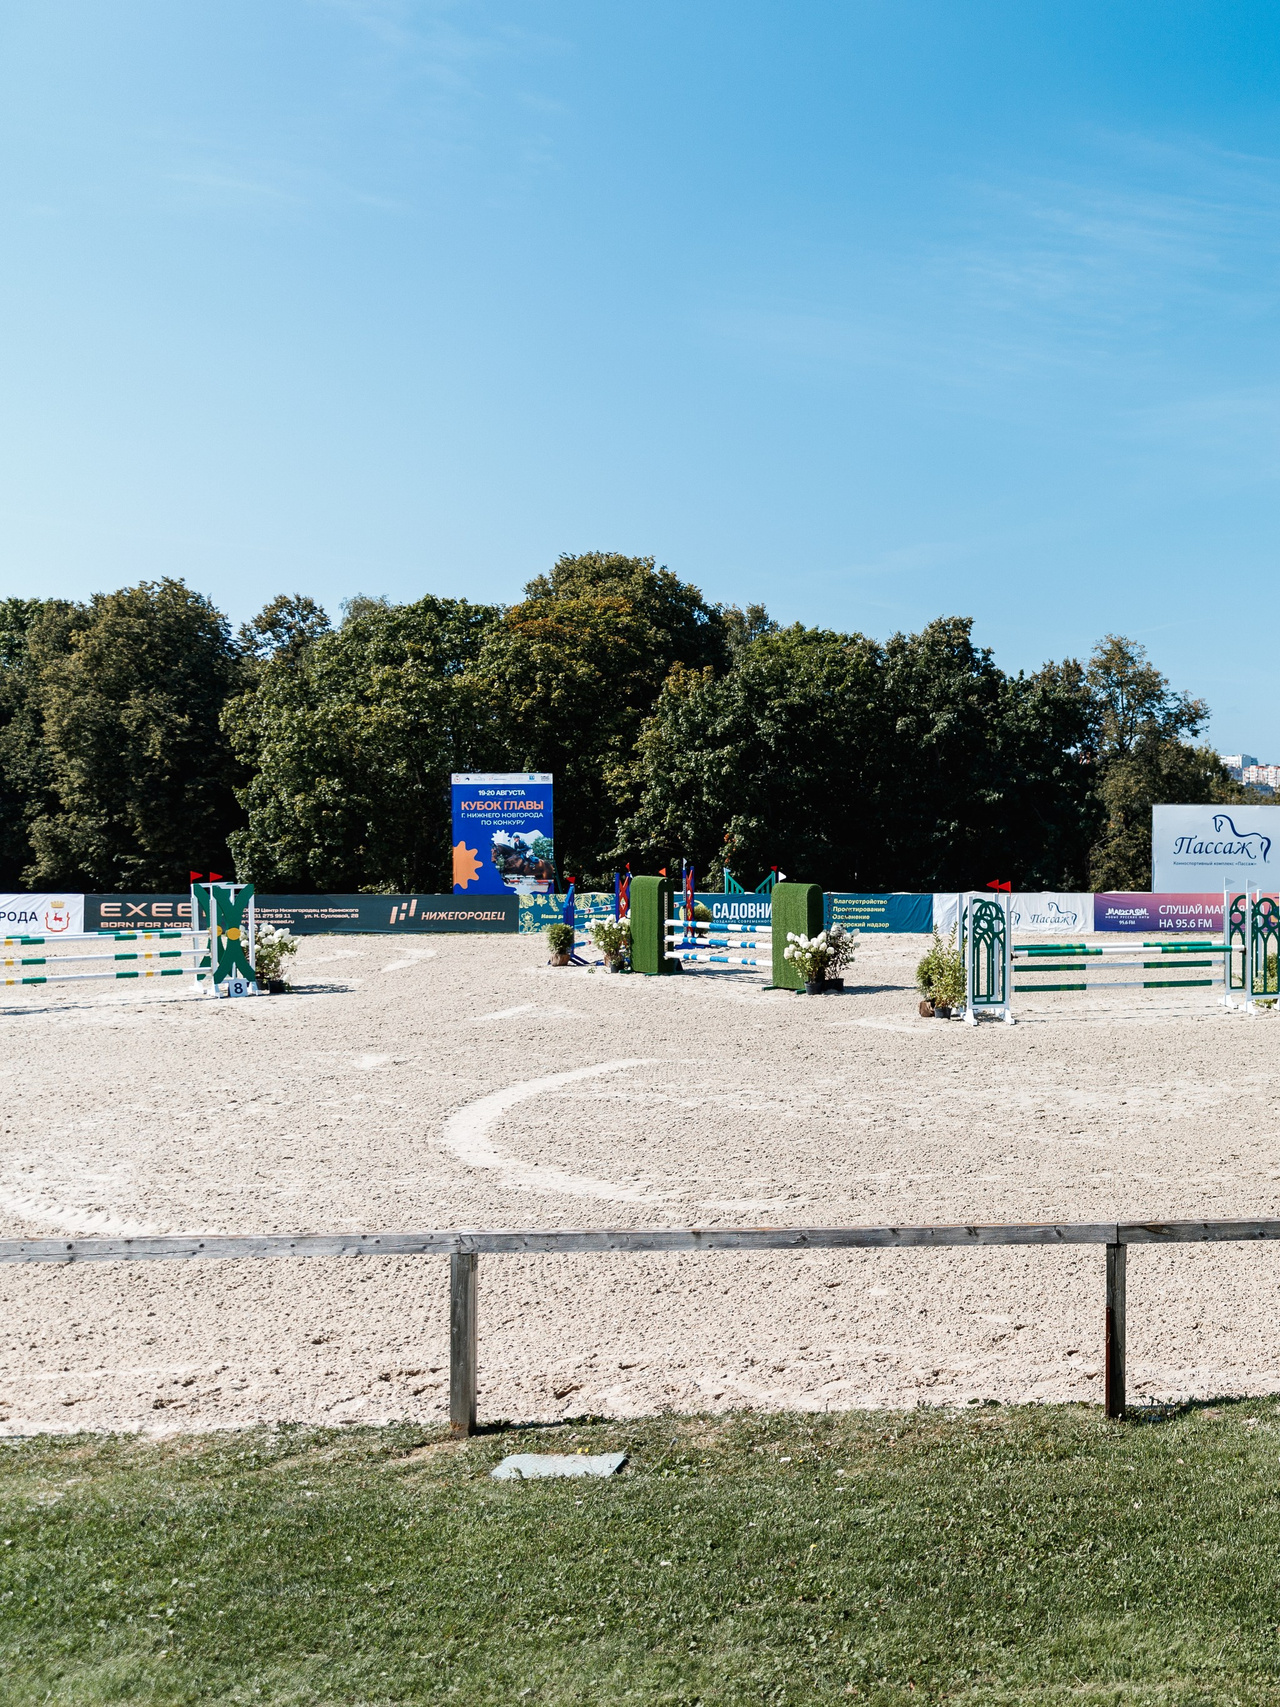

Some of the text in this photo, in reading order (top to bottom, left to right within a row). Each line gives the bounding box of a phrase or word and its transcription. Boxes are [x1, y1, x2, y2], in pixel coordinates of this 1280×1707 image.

[461, 801, 544, 811] КУБОК ГЛАВЫ
[1173, 835, 1257, 859] Пассаж
[100, 903, 192, 917] EXEE
[713, 903, 772, 919] САДОВНИ
[1159, 904, 1202, 914] СЛУШАЙ
[421, 912, 505, 921] НИЖЕГОРОДЕЦ
[1030, 914, 1071, 926] Пассаж
[1160, 919, 1213, 928] НА 95.6 FM
[234, 982, 243, 994] 8
